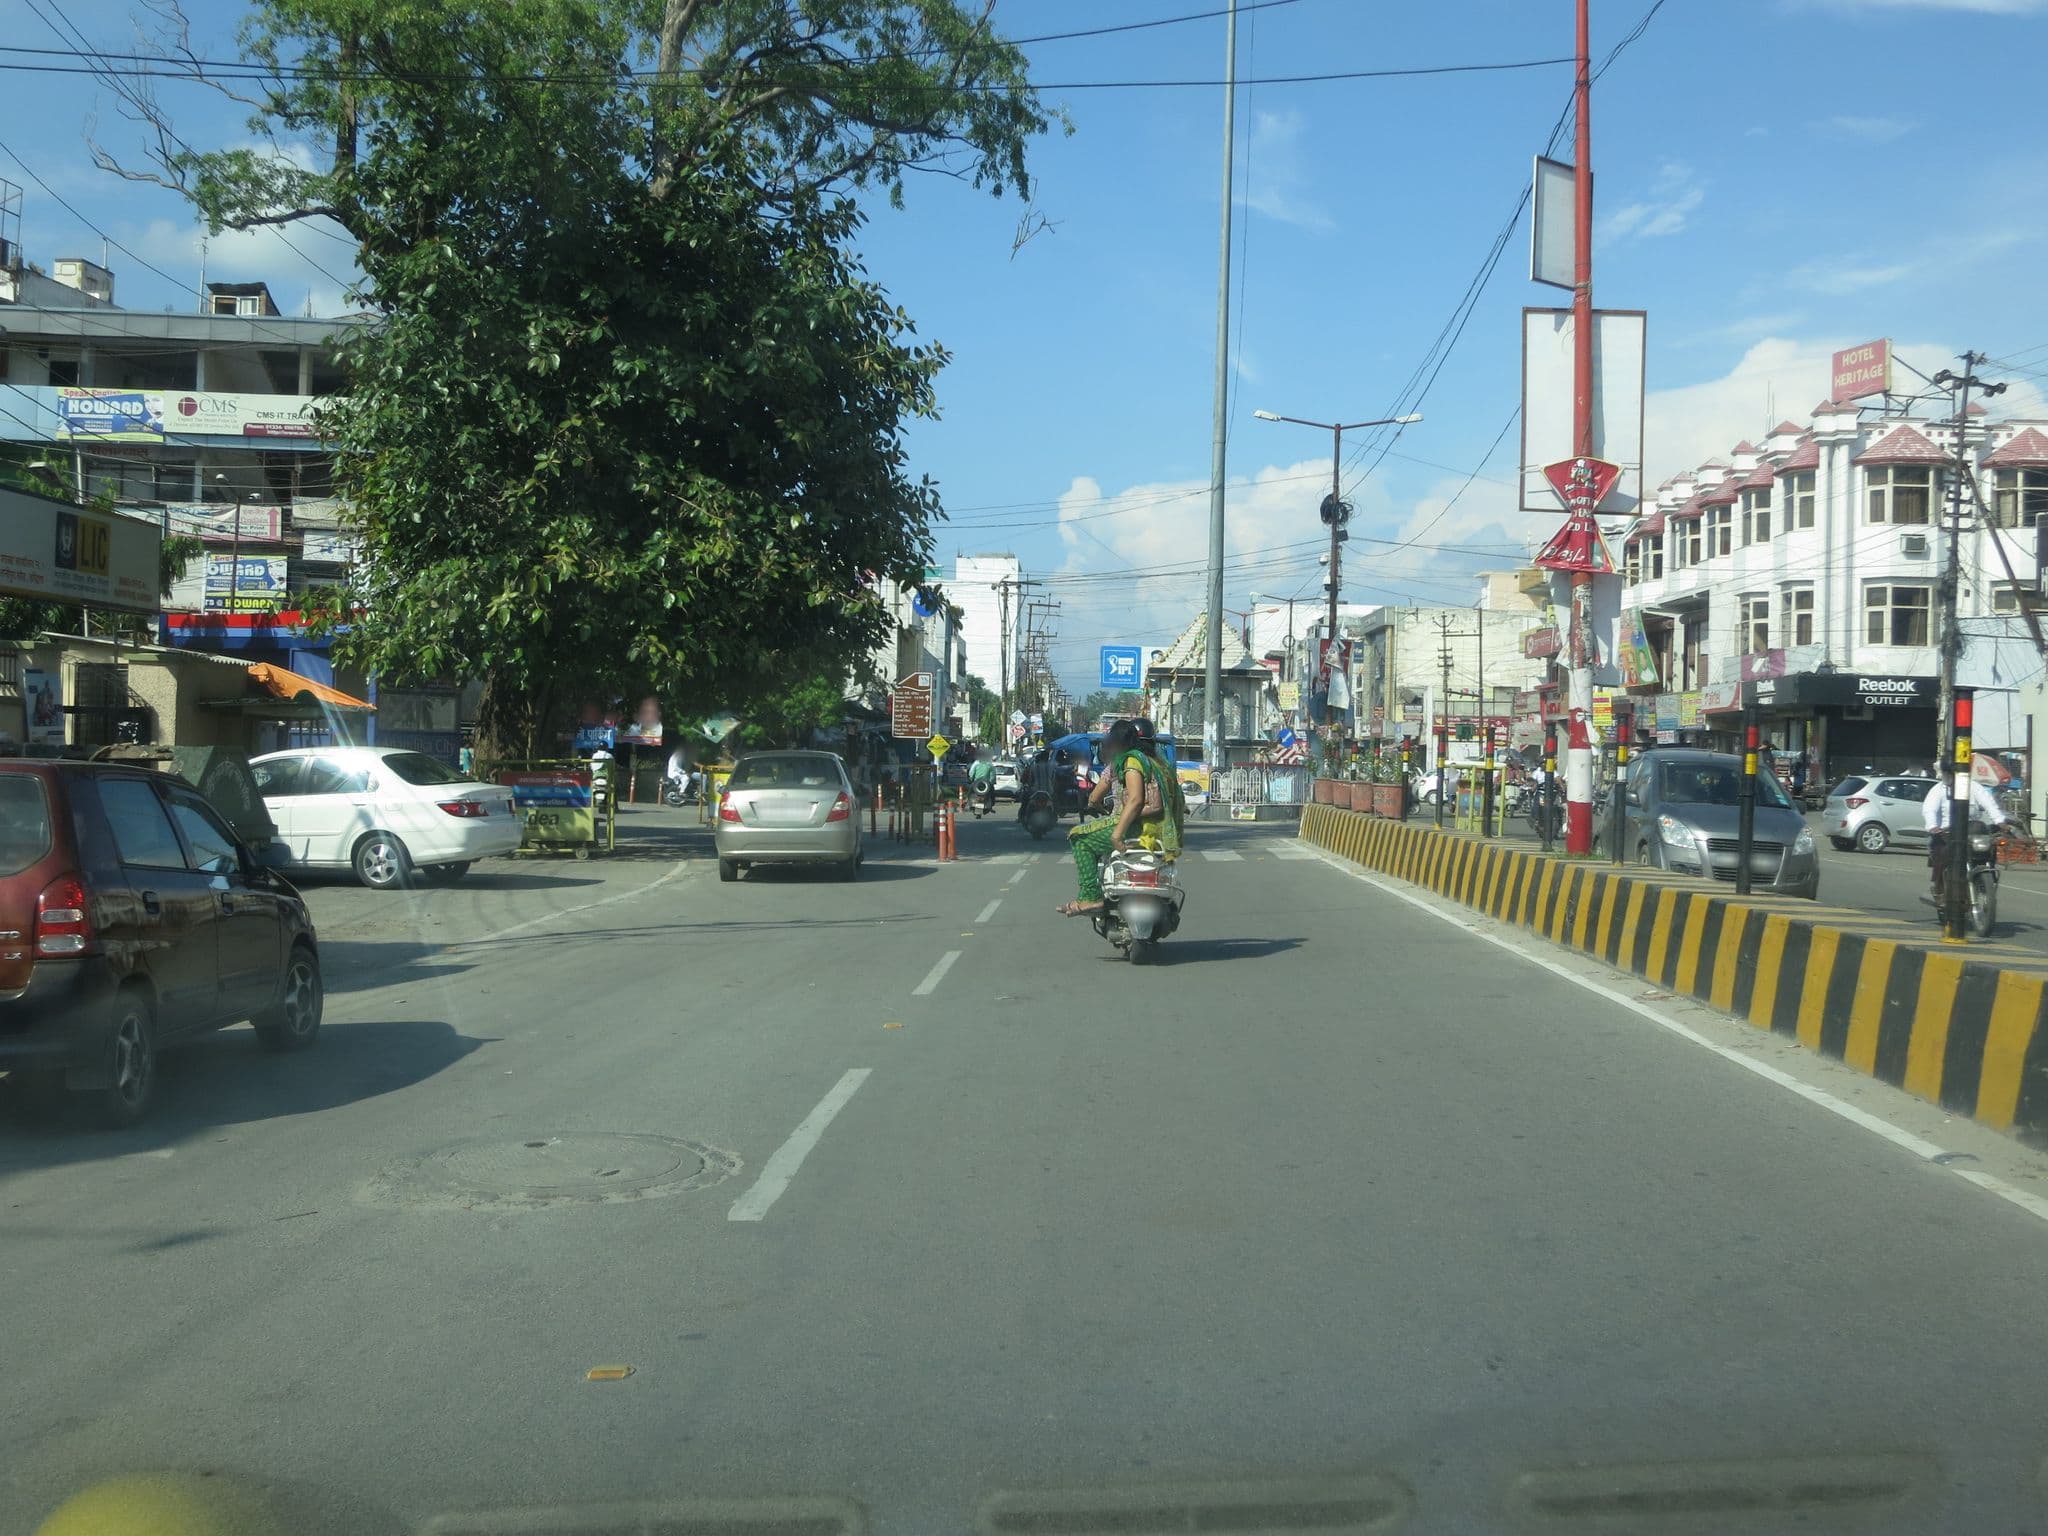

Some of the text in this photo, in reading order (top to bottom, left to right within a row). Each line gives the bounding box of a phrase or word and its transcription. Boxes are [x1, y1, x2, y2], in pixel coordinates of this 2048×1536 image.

[1842, 347, 1874, 367] HOTEL
[1834, 364, 1884, 388] HERITAGE
[199, 399, 238, 413] CMS
[256, 411, 275, 419] CMS
[80, 521, 108, 570] LIC
[1117, 665, 1134, 675] IPL
[1859, 678, 1916, 692] Reebok
[1864, 696, 1910, 705] OUTLET
[525, 809, 560, 826] dea
